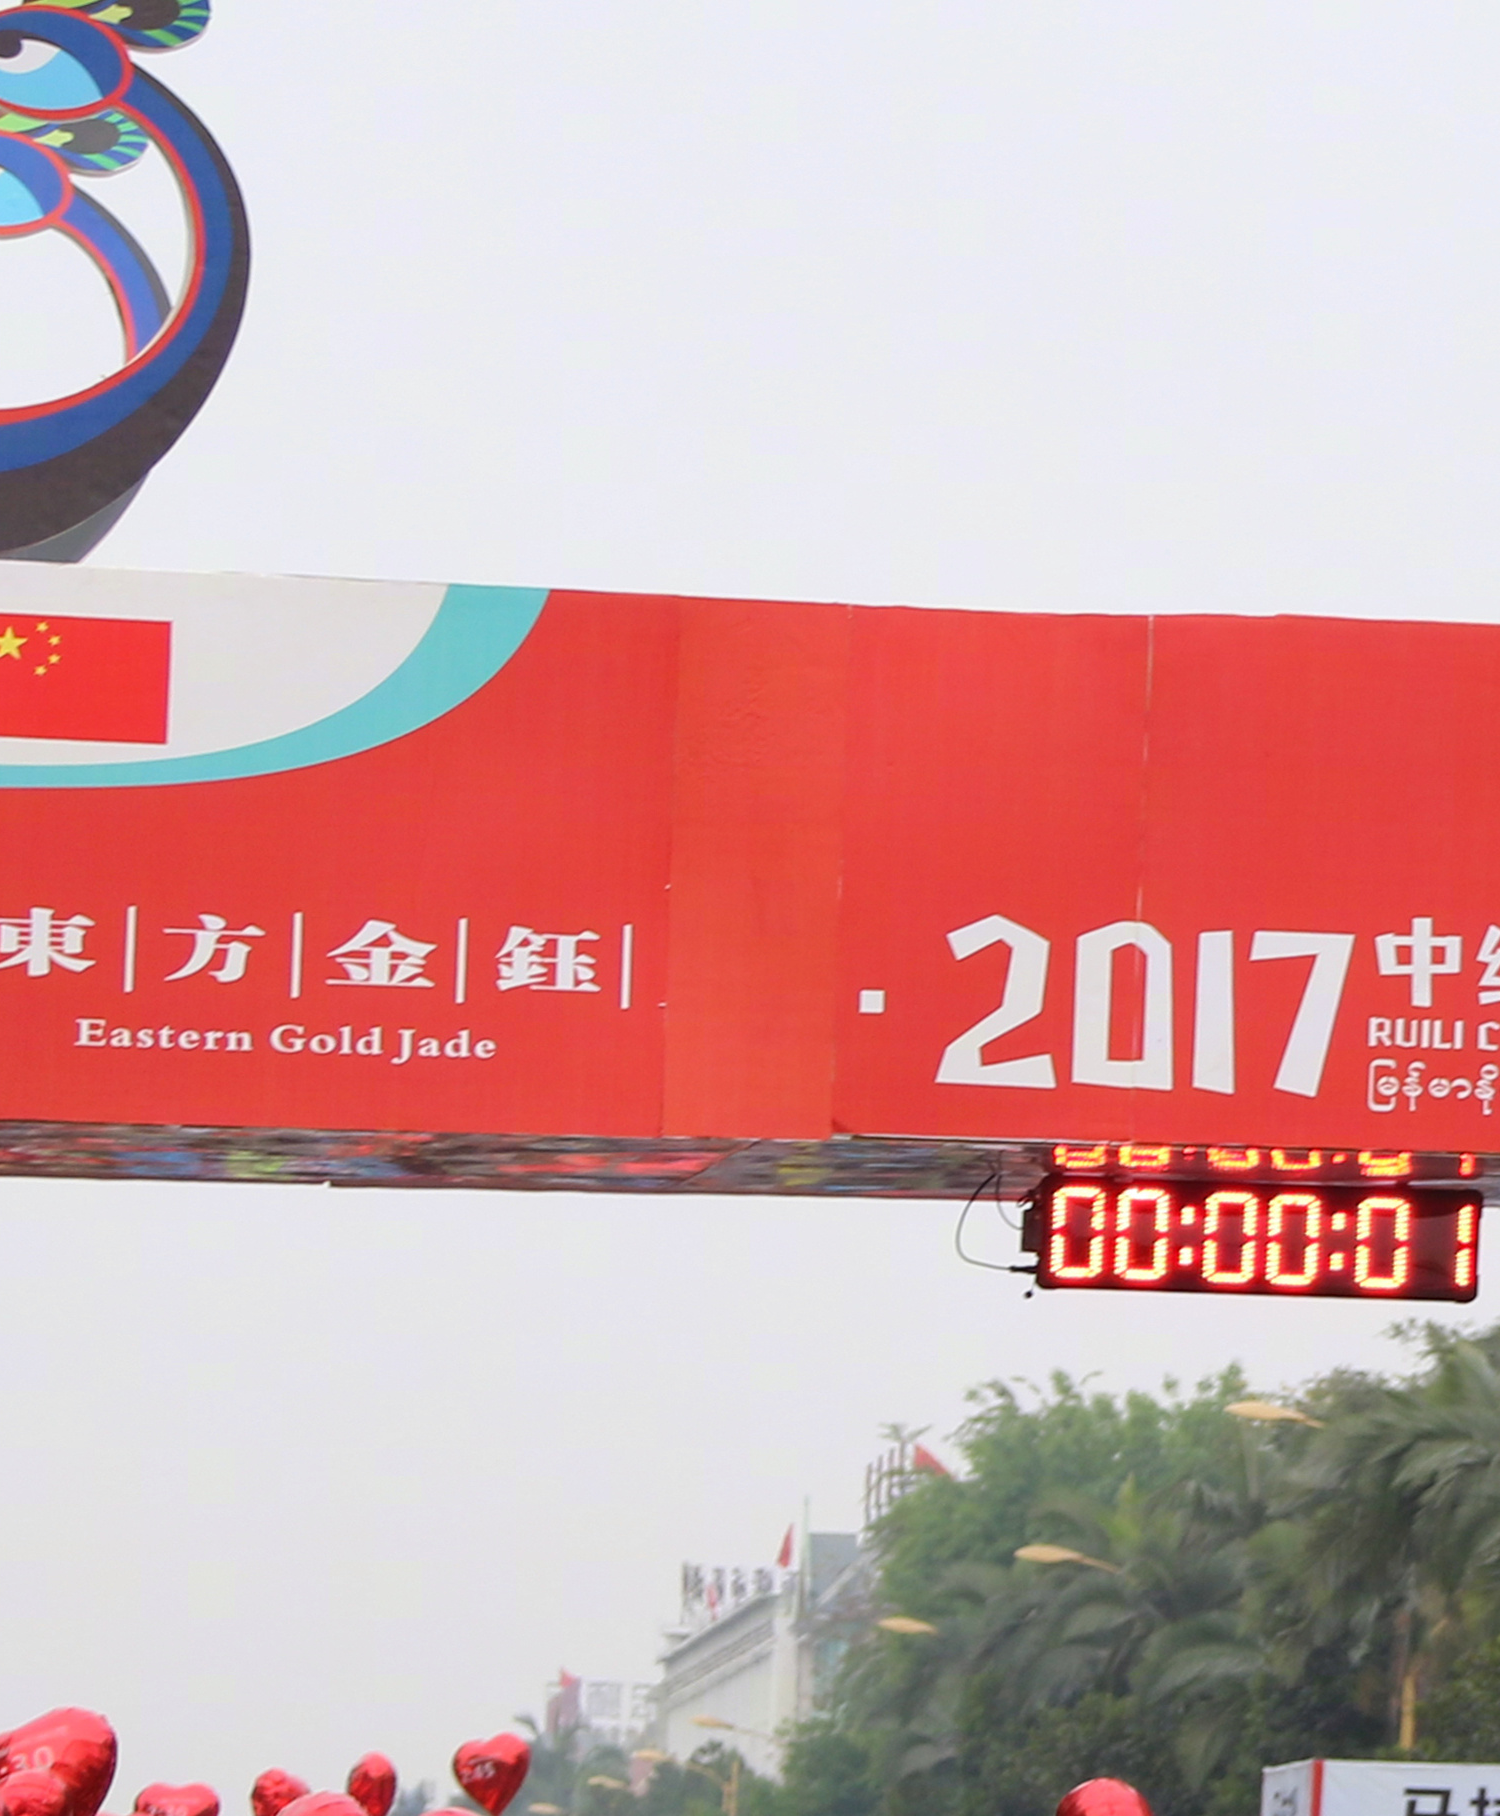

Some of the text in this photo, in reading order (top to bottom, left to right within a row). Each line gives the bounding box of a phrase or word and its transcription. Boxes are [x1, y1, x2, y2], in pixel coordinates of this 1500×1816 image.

[75, 1016, 499, 1066] Eastern Gold Jade
[933, 912, 1357, 1098] 2017
[1367, 1016, 1465, 1051] RUILI
[1049, 1185, 1476, 1290] 00:00:01
